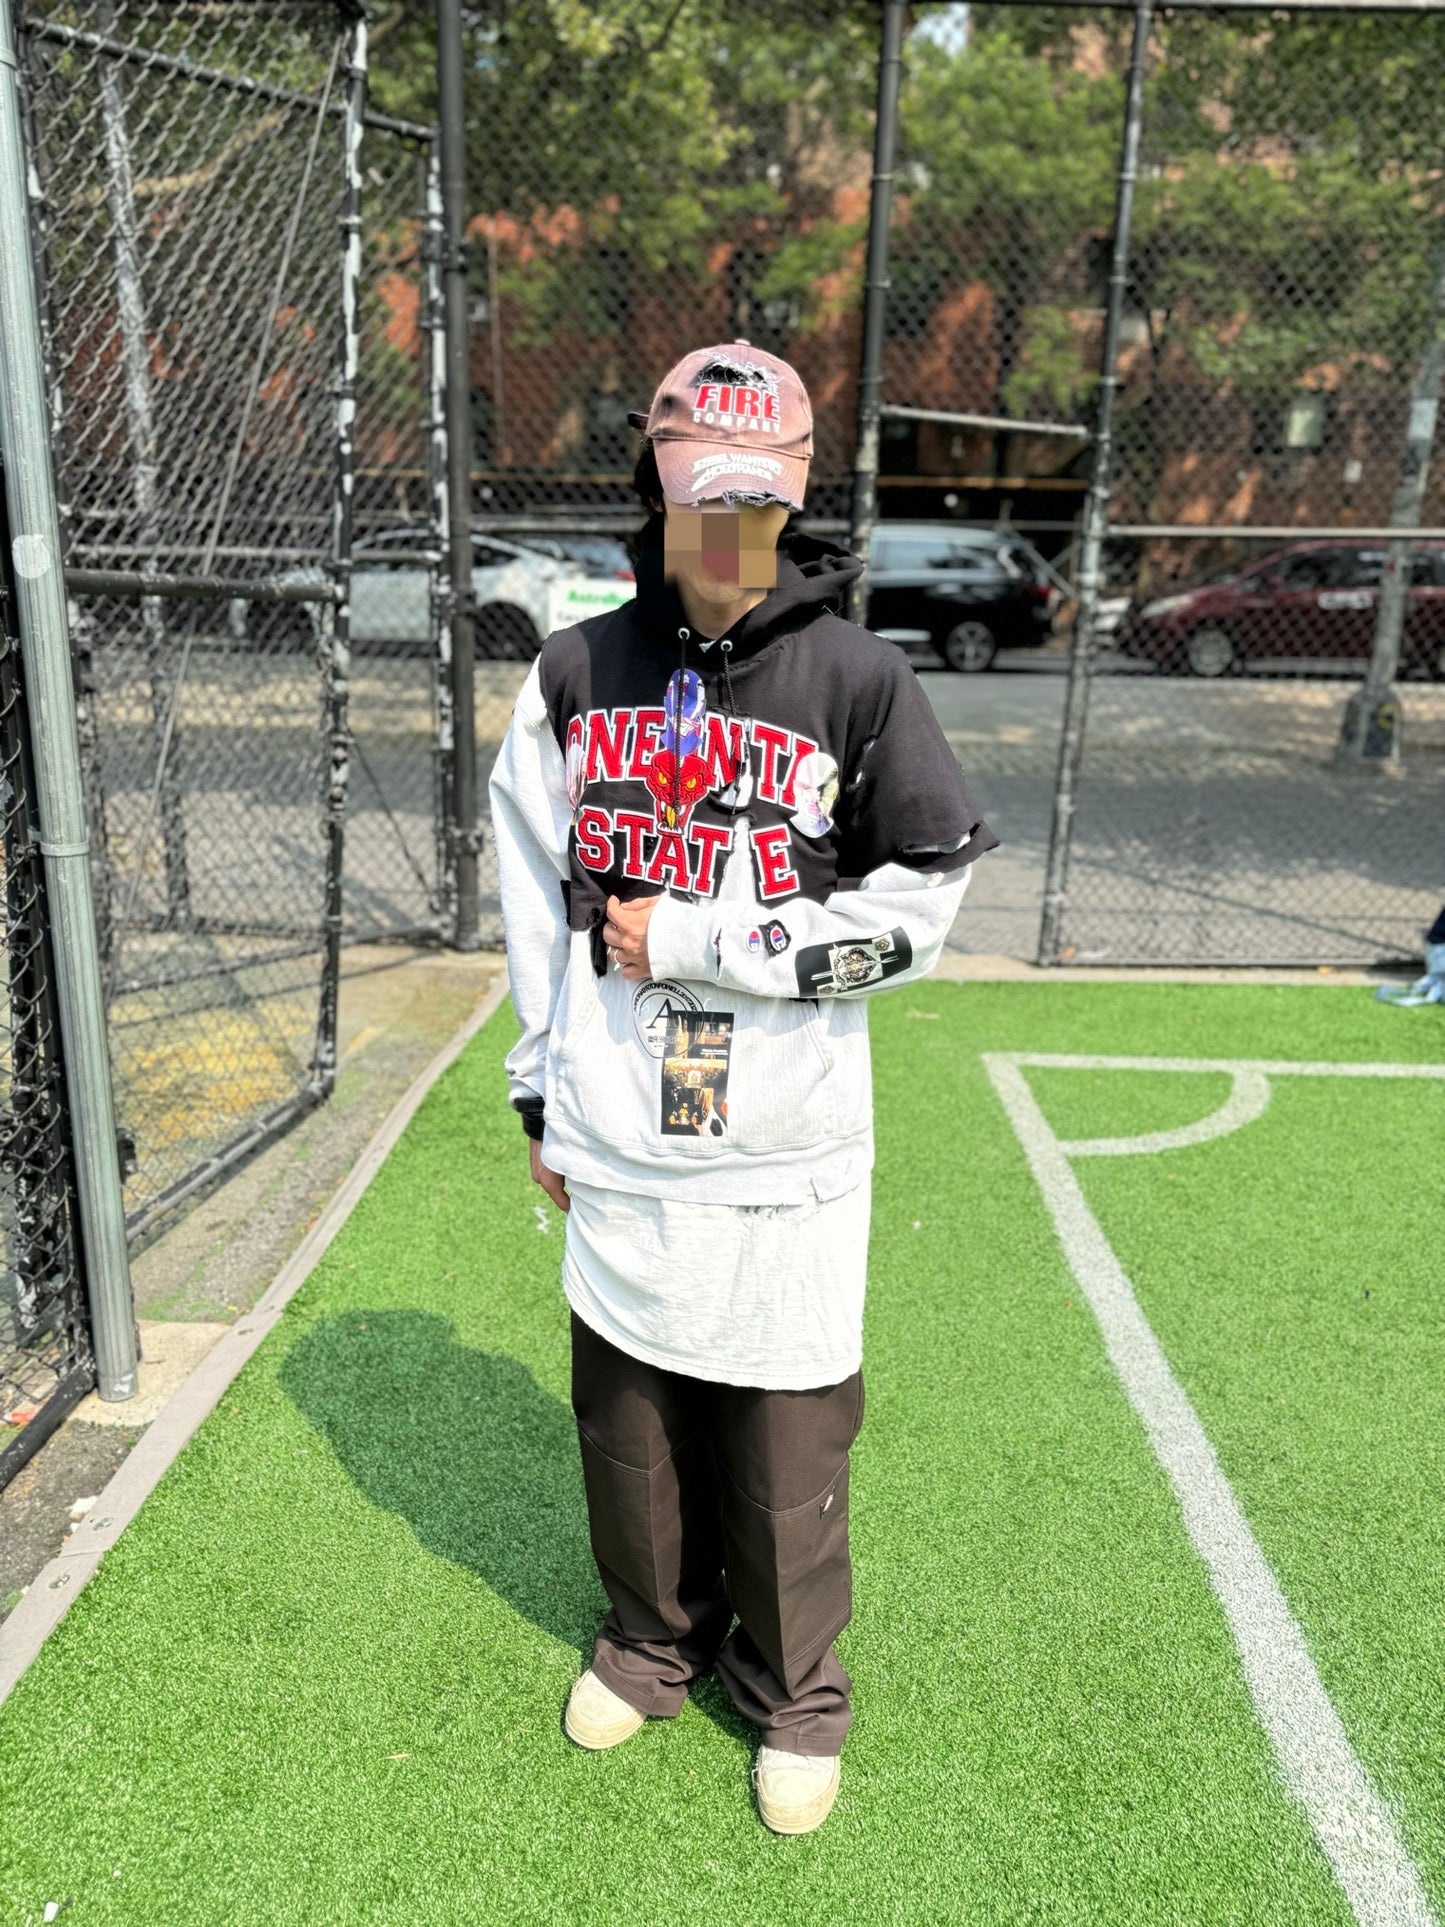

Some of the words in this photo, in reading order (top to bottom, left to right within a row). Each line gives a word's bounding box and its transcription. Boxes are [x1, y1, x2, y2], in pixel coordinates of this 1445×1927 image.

[694, 384, 781, 422] FIRE
[693, 412, 781, 434] COMPANY
[575, 804, 800, 900] STATE
[646, 998, 679, 1029] A
